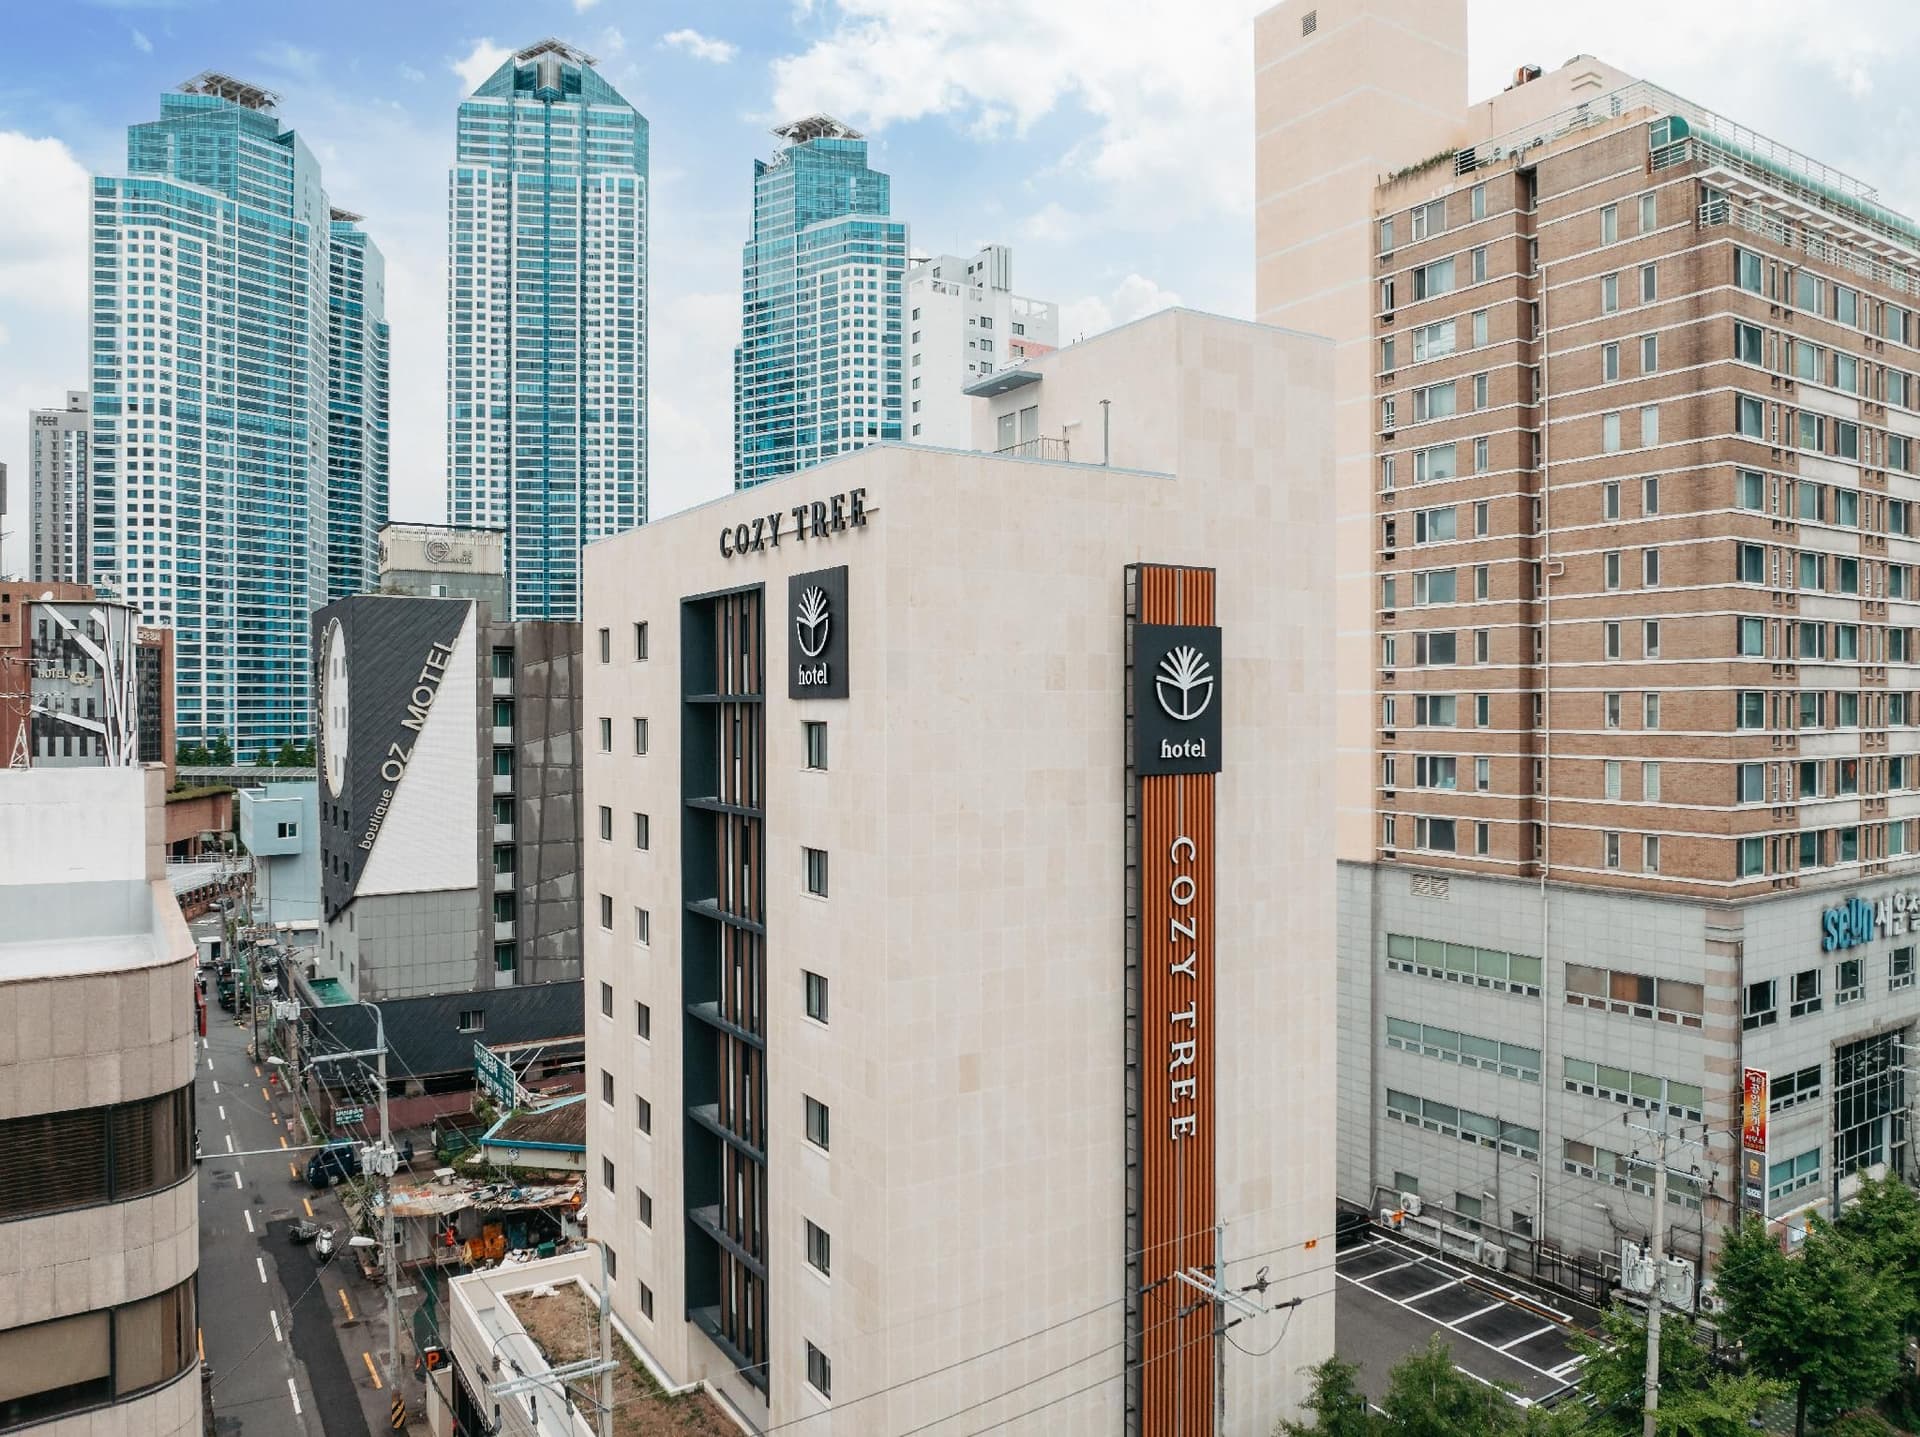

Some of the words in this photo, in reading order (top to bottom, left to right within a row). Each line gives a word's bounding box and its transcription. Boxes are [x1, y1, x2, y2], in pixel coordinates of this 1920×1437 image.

[719, 512, 783, 559] COZY
[792, 487, 867, 542] TREE
[798, 663, 828, 685] hotel
[358, 789, 393, 850] boutique
[381, 742, 413, 782] OZ
[401, 638, 458, 731] MOTEL
[1160, 737, 1206, 759] hotel
[1170, 836, 1197, 981] COZY
[1169, 1001, 1196, 1141] TREE
[426, 1351, 440, 1372] P
